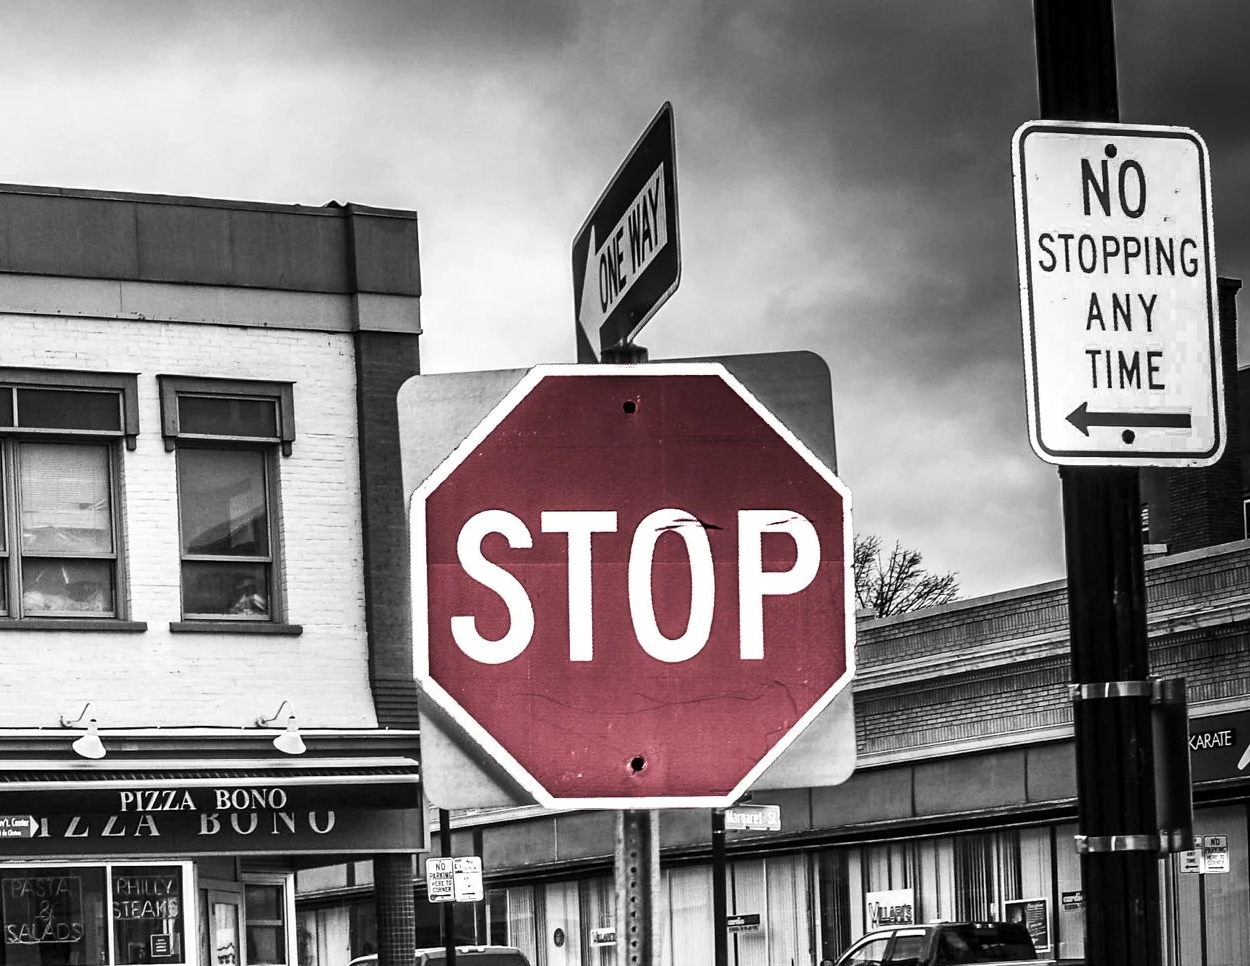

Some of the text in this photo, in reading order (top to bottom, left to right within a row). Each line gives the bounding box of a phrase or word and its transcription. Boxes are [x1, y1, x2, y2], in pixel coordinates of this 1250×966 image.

[1081, 158, 1147, 219] NO
[599, 176, 659, 314] ONE WAY
[1038, 232, 1199, 278] STOPPING
[1086, 292, 1158, 333] ANY
[1085, 350, 1165, 390] TIME
[450, 508, 821, 665] STOP
[1189, 730, 1232, 750] KARATE
[120, 788, 288, 812] PIZZA BONO
[11, 817, 30, 827] Center
[38, 811, 336, 837] IZZA BONO
[725, 809, 763, 827] Margaret
[1210, 837, 1221, 846] NO
[430, 871, 453, 880] PARKING
[435, 862, 446, 871] NO
[11, 881, 72, 898] PASTA
[116, 877, 173, 896] PHILLY
[113, 899, 179, 918] STEAKS
[6, 921, 83, 943] SALADS
